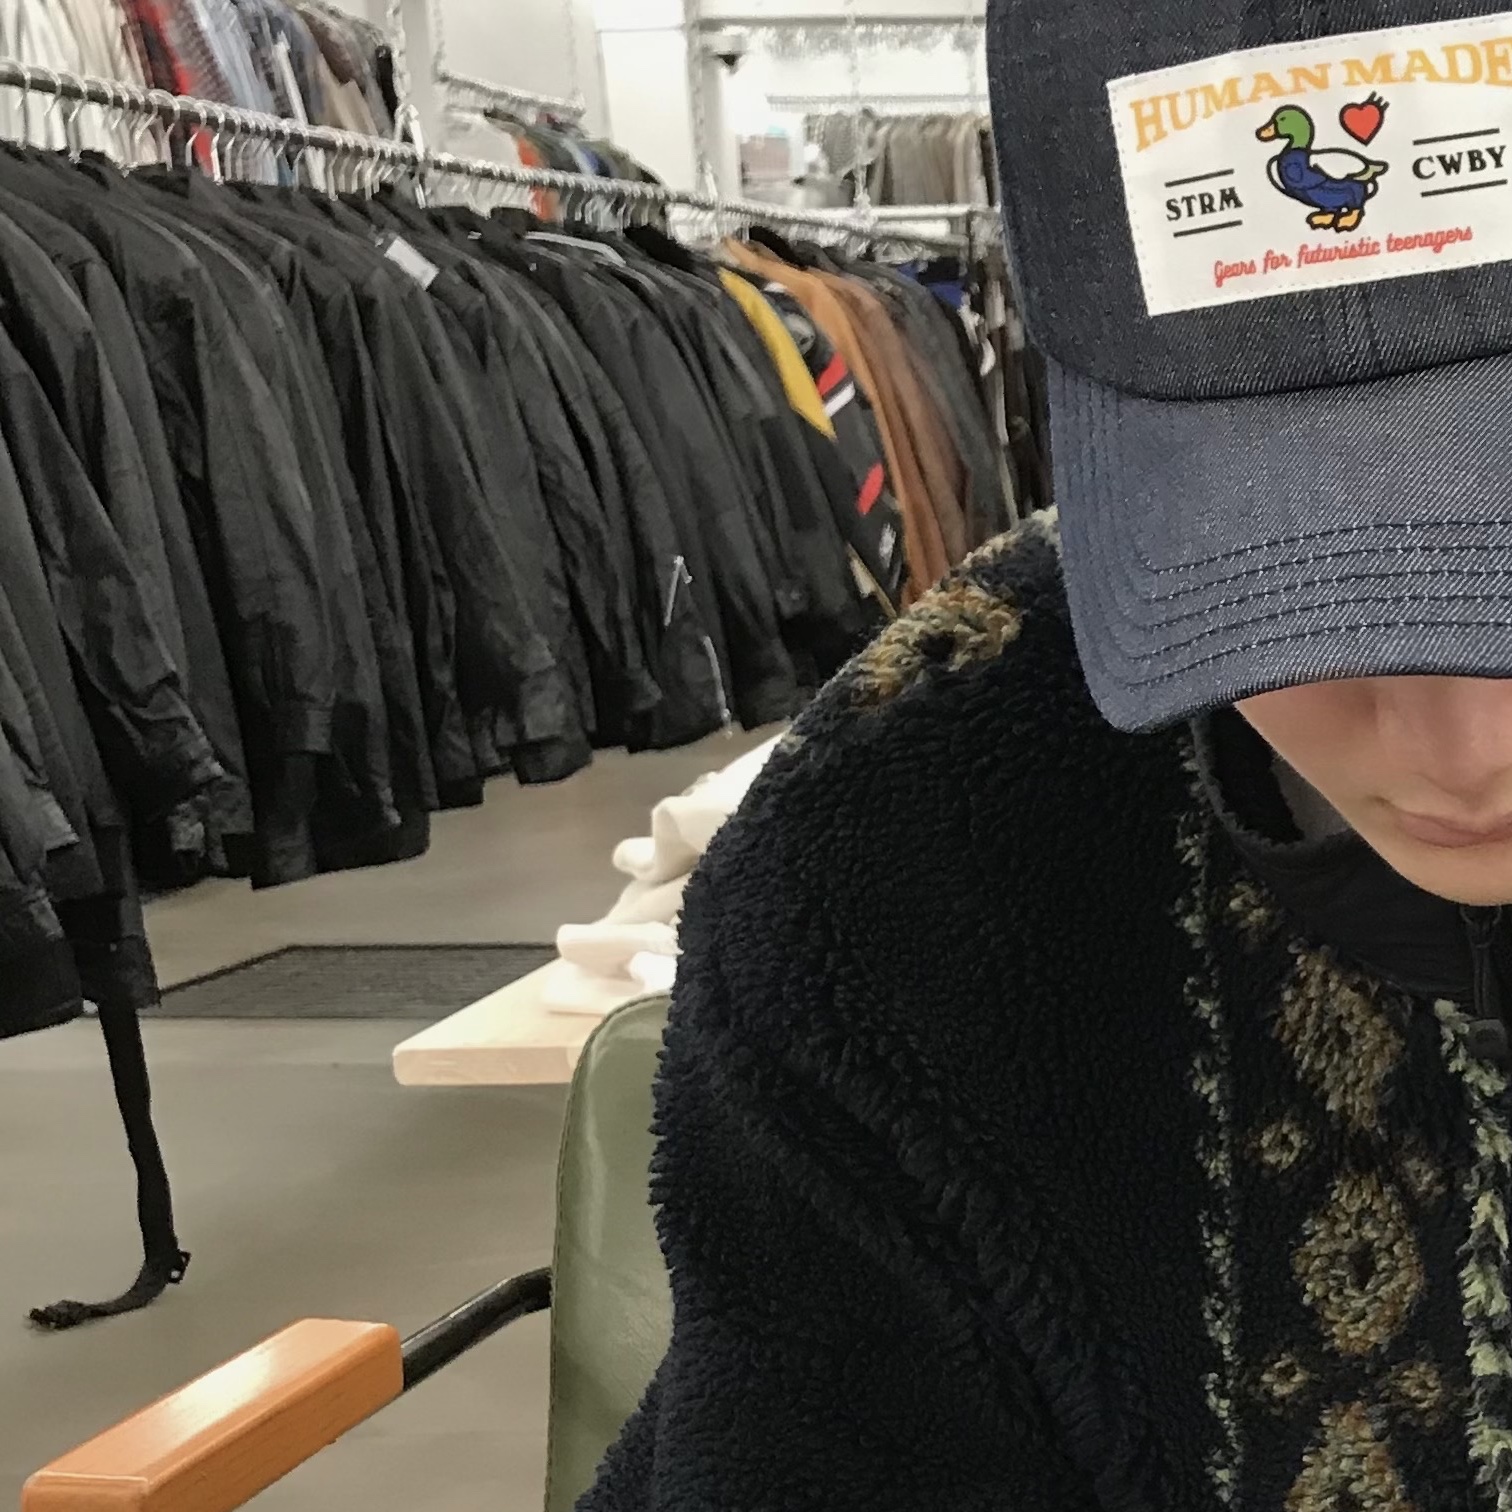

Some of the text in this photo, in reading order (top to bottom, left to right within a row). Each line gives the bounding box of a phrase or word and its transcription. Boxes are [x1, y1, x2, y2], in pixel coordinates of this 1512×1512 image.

[1129, 63, 1330, 152] HUMAN
[1412, 145, 1507, 180] CWBY
[1165, 187, 1244, 222] STRM
[1213, 225, 1473, 288] Gears for futuristic teenagers
